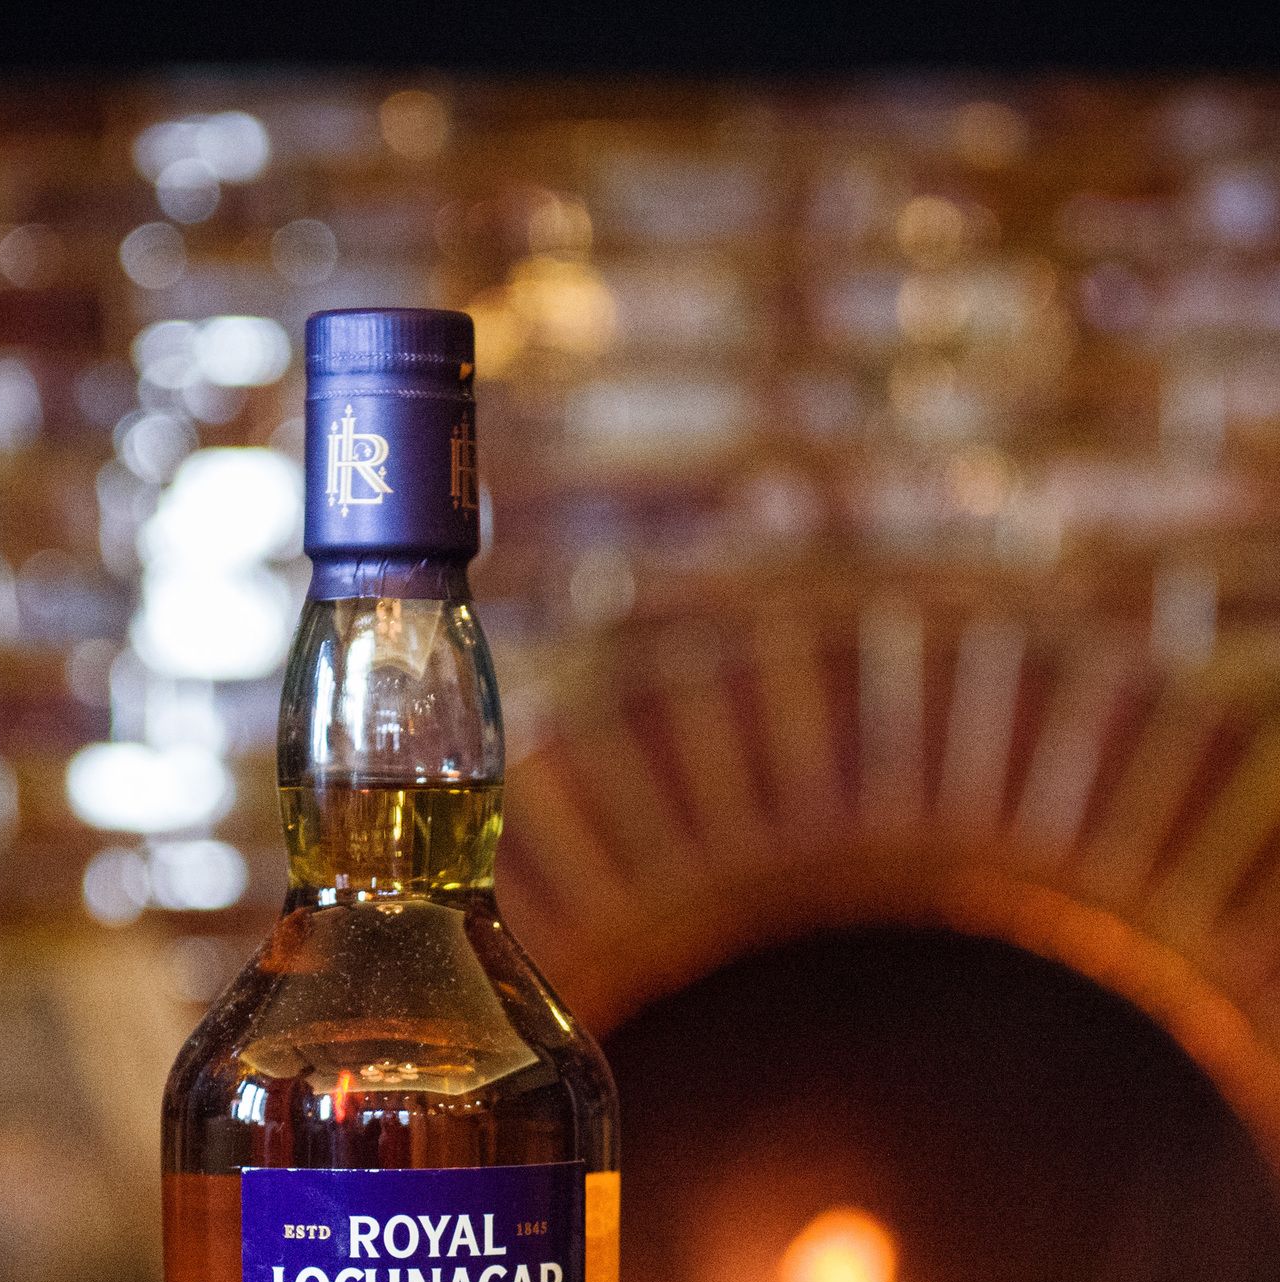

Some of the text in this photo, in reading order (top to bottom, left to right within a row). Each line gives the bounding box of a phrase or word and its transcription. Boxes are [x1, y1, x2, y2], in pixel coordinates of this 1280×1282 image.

[283, 1213, 548, 1259] ESTD ROYAL 1845
